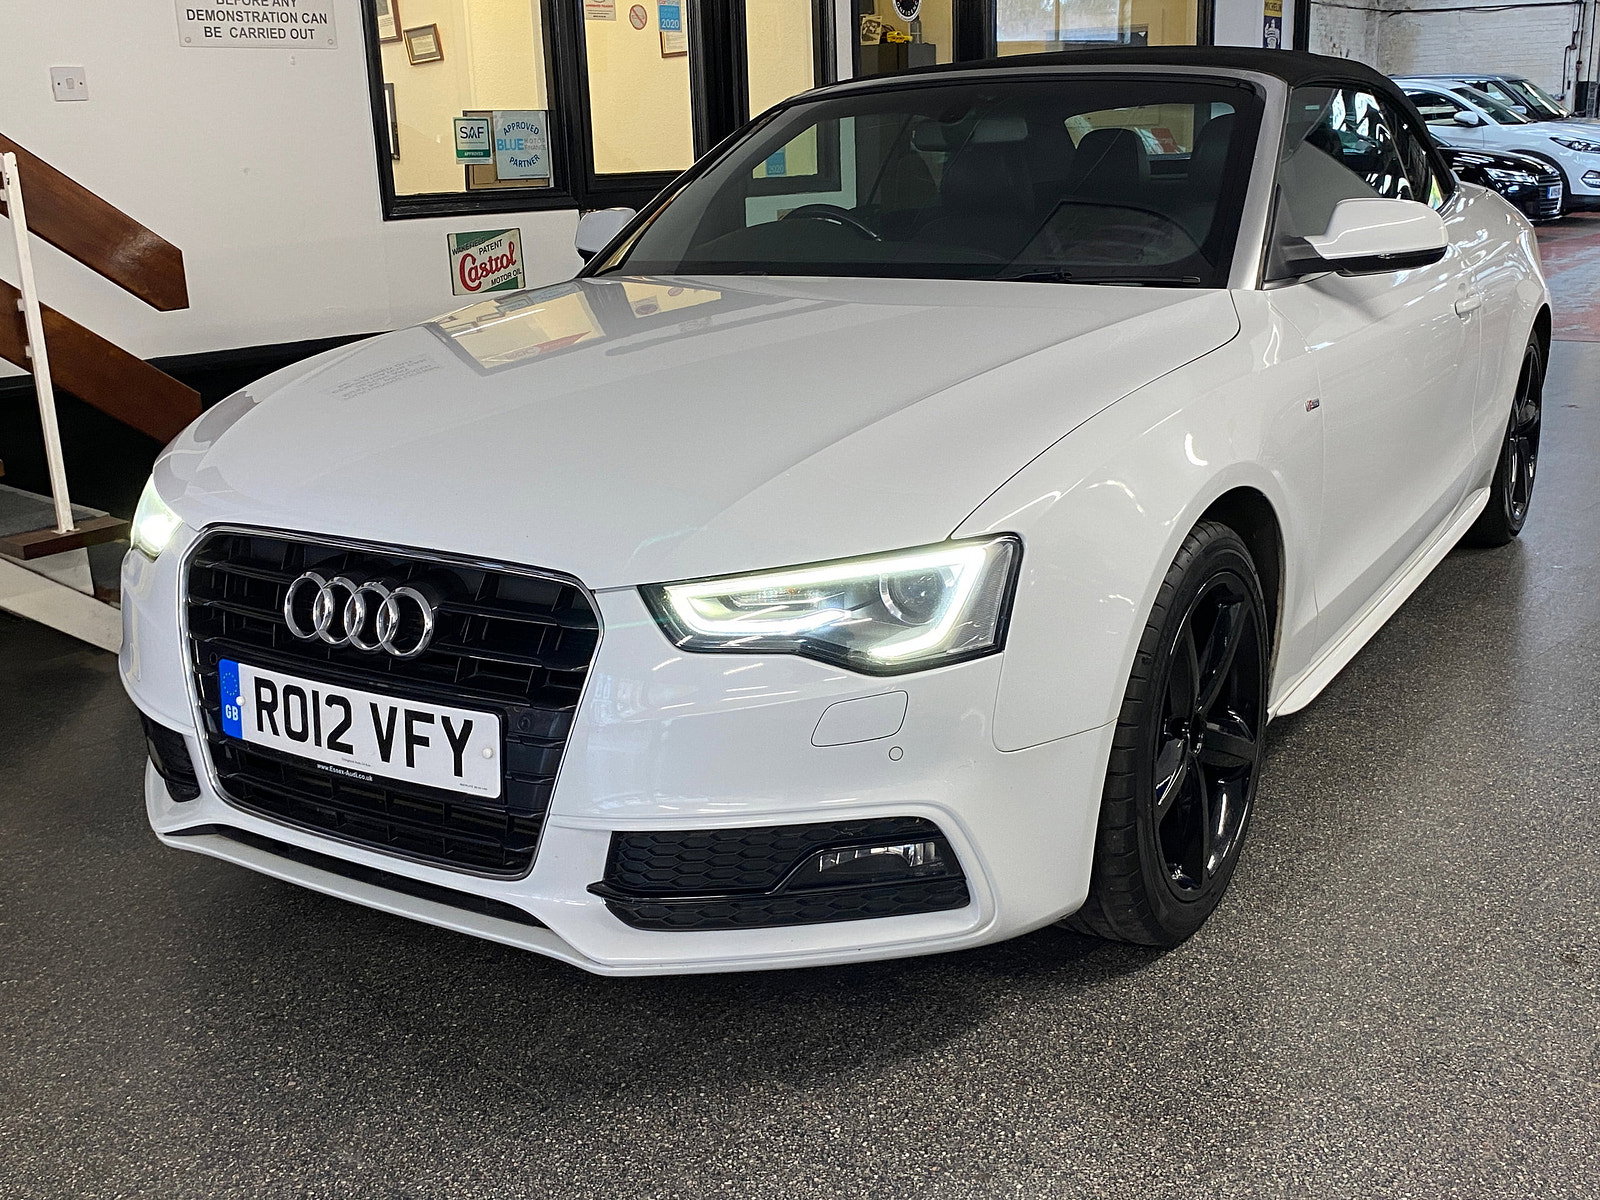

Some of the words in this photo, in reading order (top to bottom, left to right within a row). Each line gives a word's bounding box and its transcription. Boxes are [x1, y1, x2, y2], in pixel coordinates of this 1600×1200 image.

[186, 9, 298, 23] DEMONSTRATION
[301, 12, 328, 24] CAN
[661, 19, 680, 29] 2020
[203, 26, 222, 38] BE
[229, 27, 286, 39] CARRIED
[290, 28, 315, 40] OUT
[459, 126, 485, 139] SAF
[503, 121, 540, 136] APPROVED
[496, 138, 525, 151] BLUE
[509, 154, 540, 168] PARTNER
[452, 236, 486, 256] WAKEFIELD
[479, 239, 503, 255] PATENT
[459, 241, 517, 292] Castrol
[491, 271, 512, 286] MOTOR
[512, 268, 522, 277] OIL
[225, 704, 239, 721] GB
[254, 676, 354, 755] RO12
[369, 702, 474, 778] VFY
